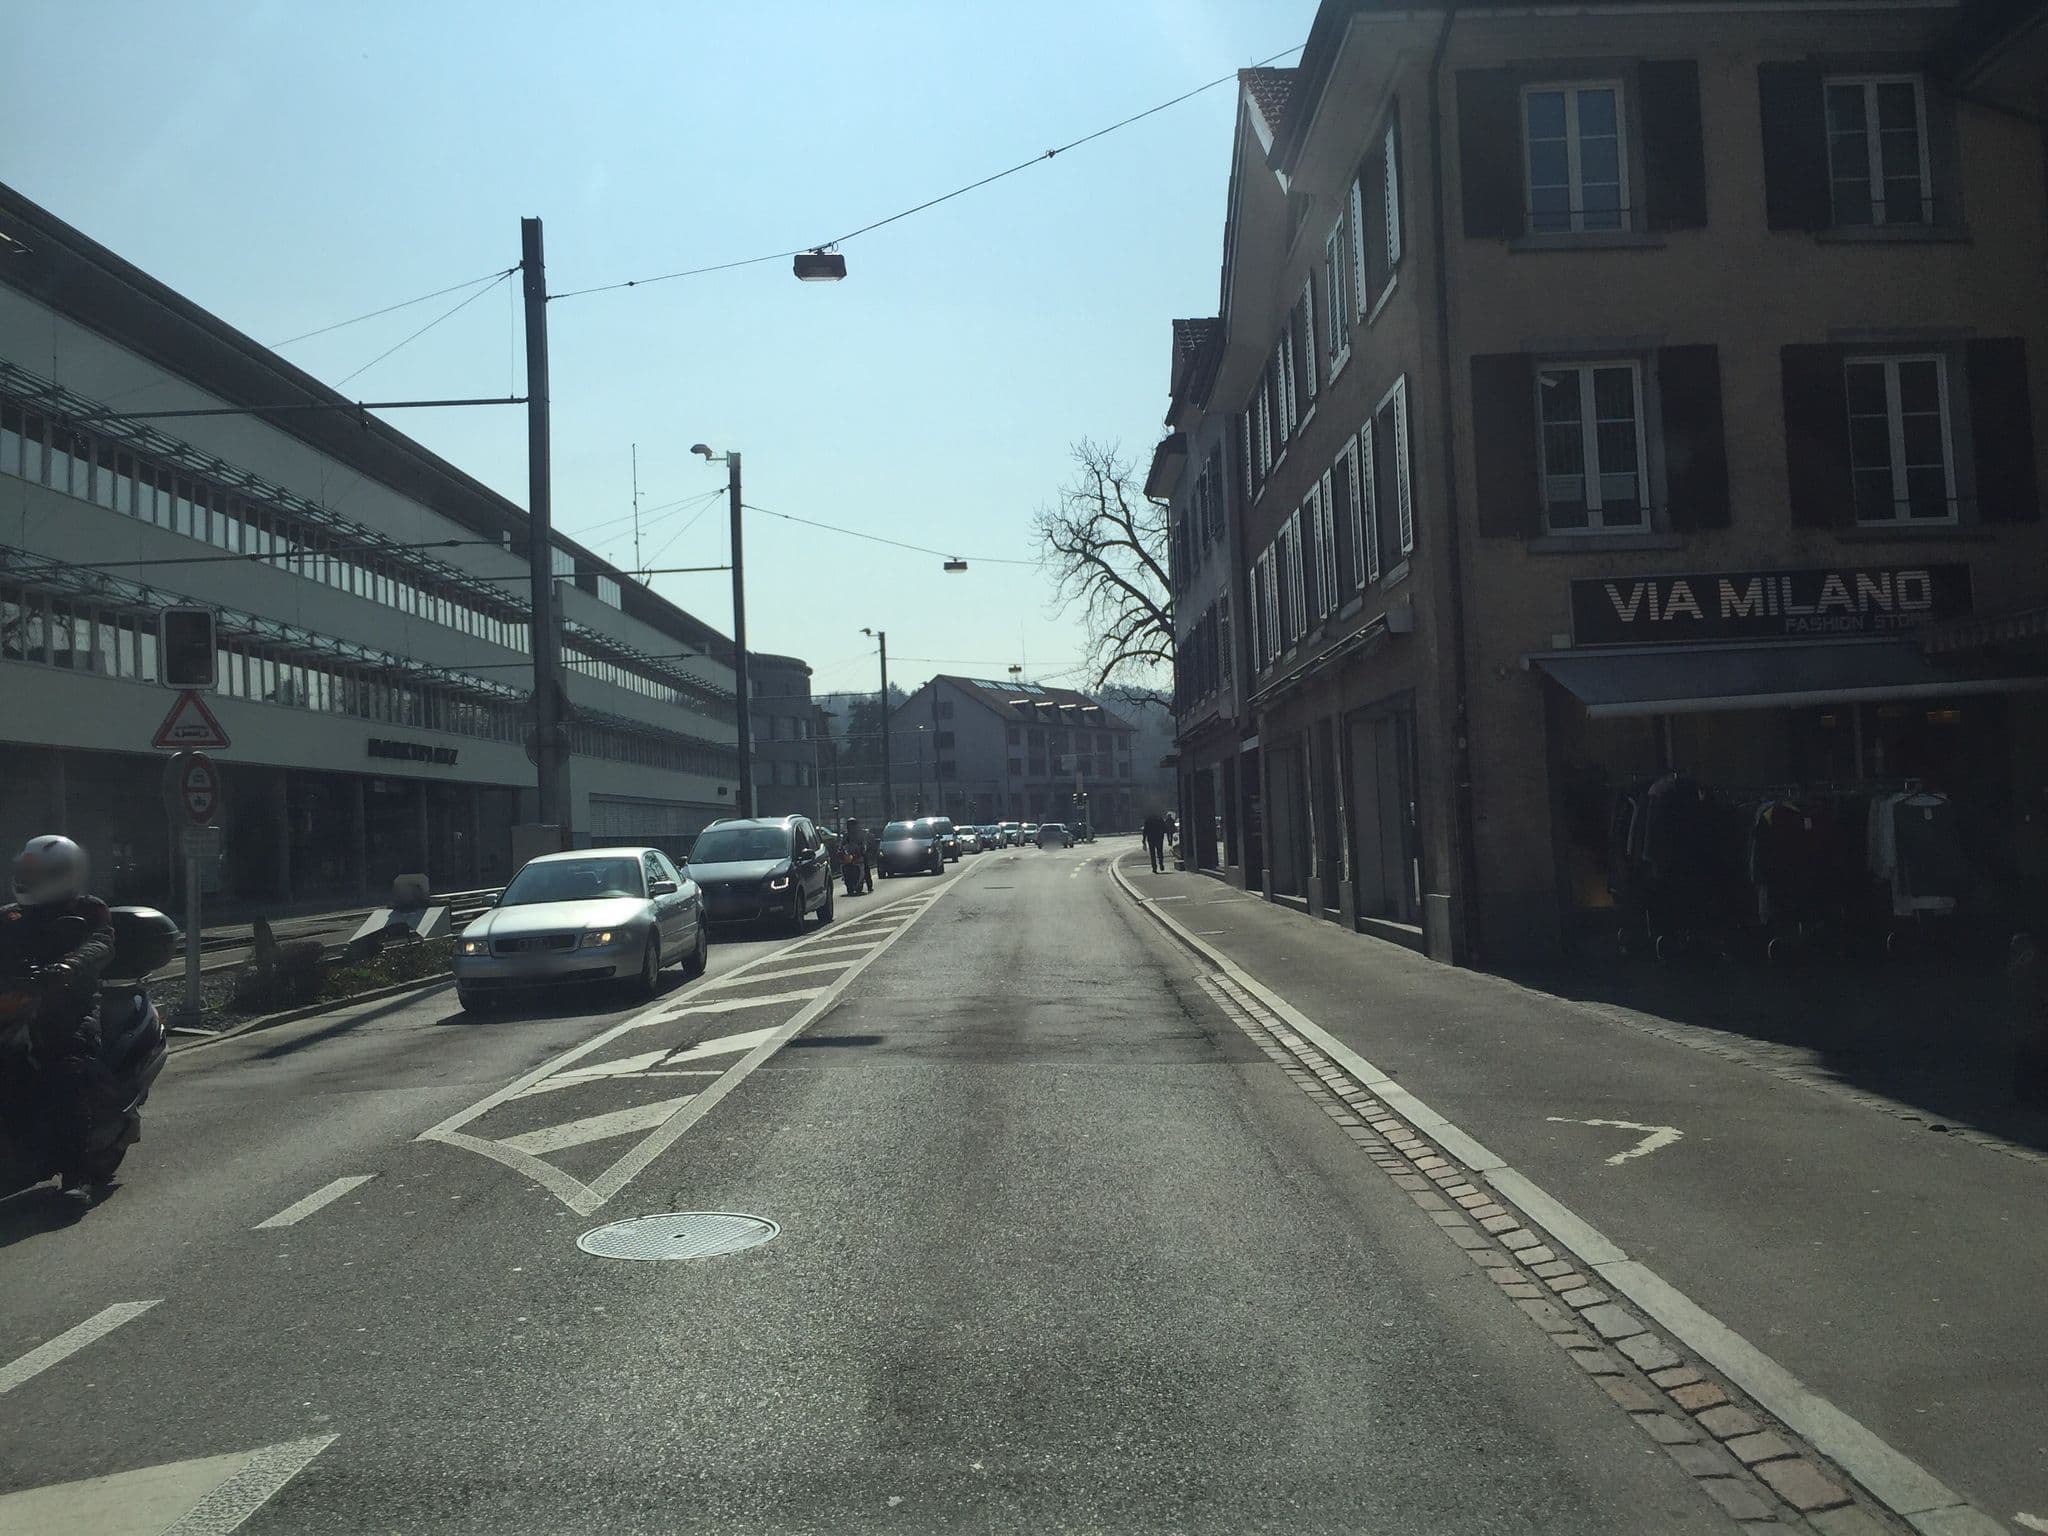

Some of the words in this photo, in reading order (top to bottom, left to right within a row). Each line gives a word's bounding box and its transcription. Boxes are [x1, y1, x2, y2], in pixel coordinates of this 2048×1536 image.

[1604, 580, 1704, 622] VIA
[1718, 570, 1932, 618] MILANO
[1785, 615, 1864, 633] FASHION
